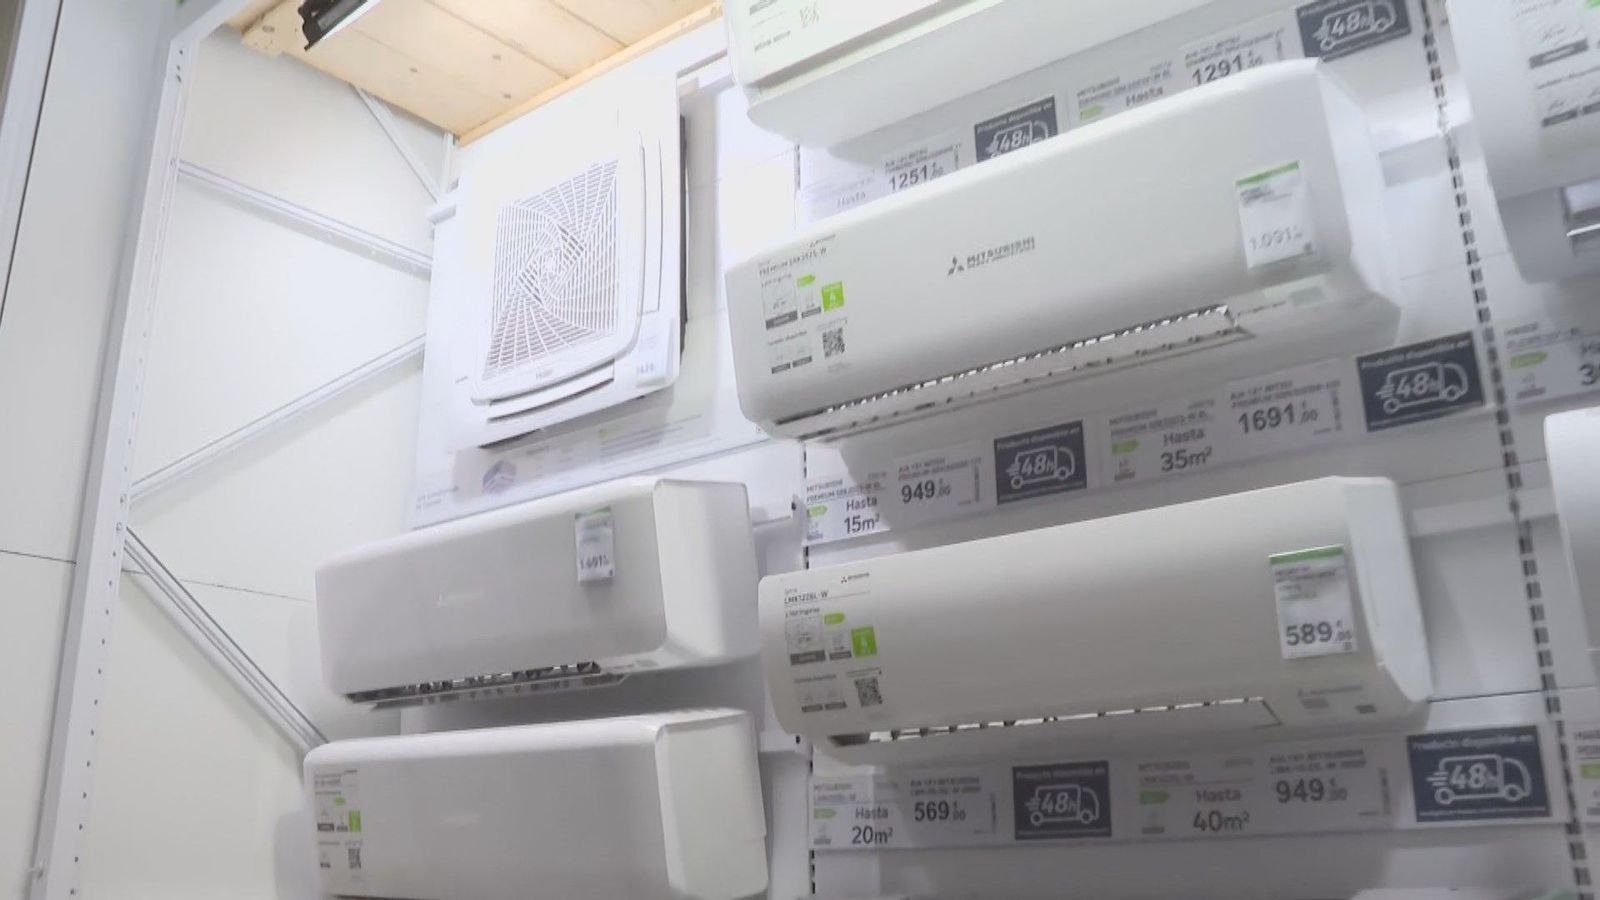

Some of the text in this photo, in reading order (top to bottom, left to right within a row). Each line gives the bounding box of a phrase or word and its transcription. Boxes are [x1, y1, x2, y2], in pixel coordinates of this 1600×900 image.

[889, 164, 928, 191] 1251
[1238, 402, 1296, 433] 1691
[1163, 428, 1206, 446] Hasta
[846, 495, 878, 511] Hasta
[901, 480, 935, 504] 949
[1285, 621, 1333, 646] 589
[1195, 788, 1242, 803] Hasta
[1275, 778, 1325, 804] 949
[855, 806, 889, 820] Hasta
[914, 800, 949, 822] 569
